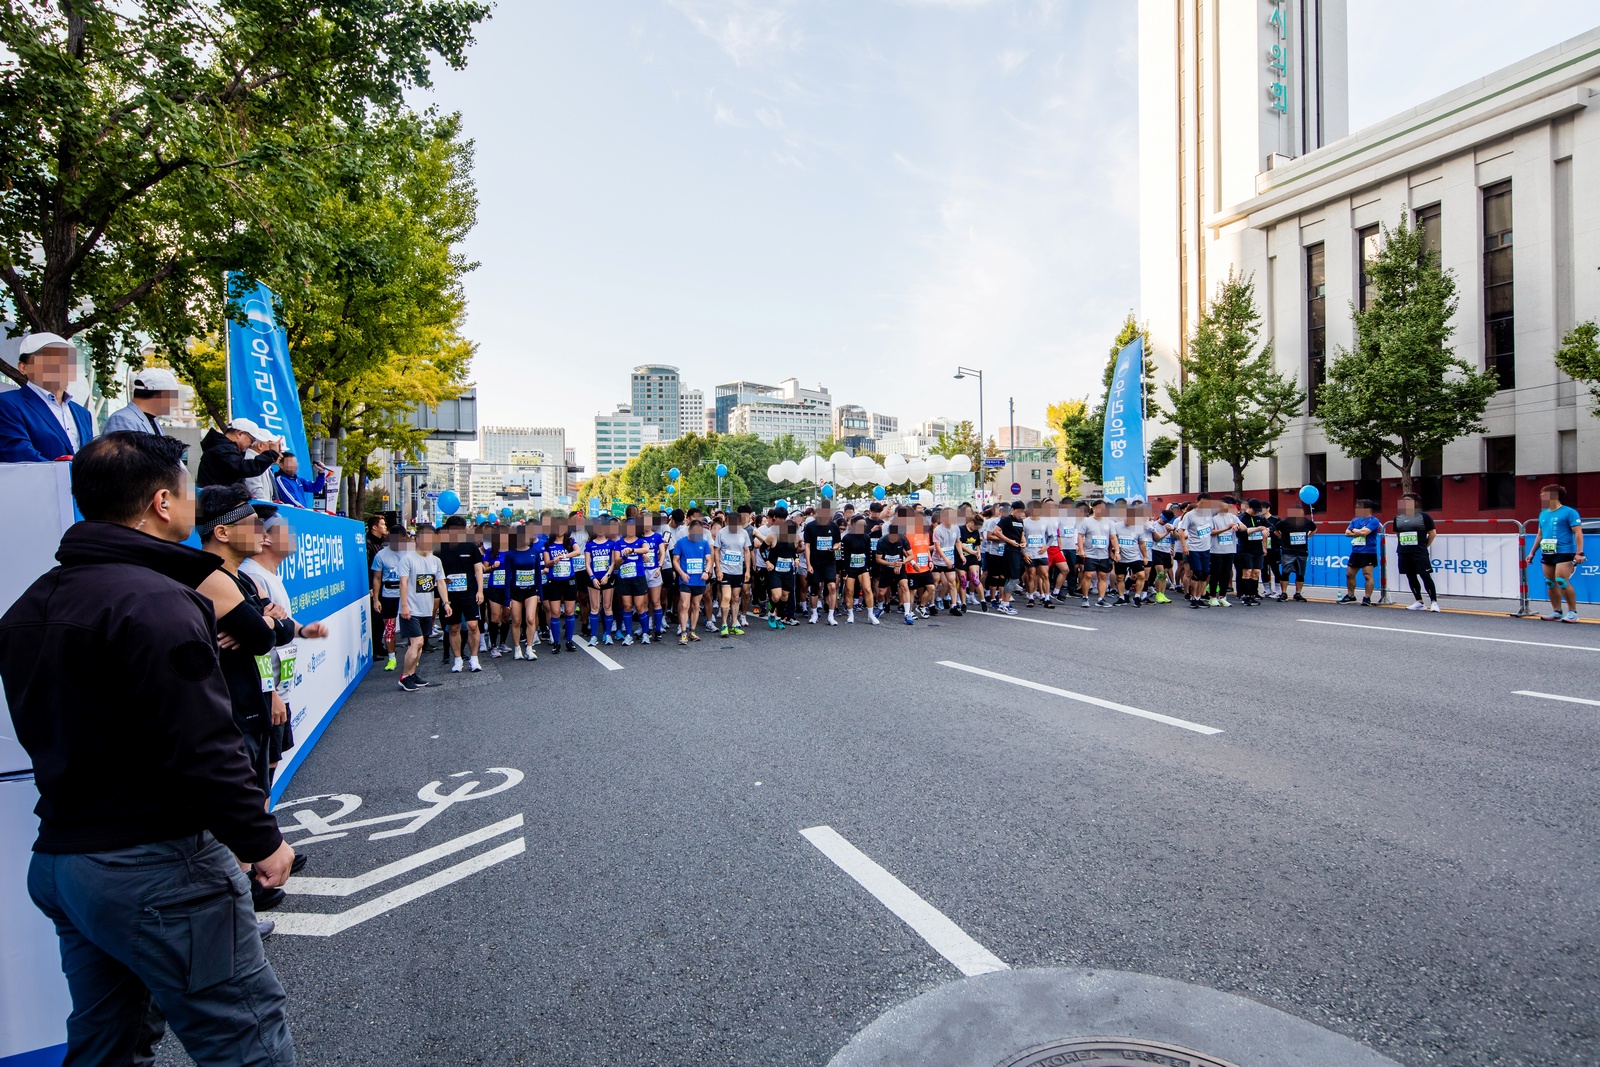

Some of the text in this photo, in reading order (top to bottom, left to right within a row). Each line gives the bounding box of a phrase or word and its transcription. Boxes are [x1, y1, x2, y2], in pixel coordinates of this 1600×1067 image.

[1270, 0, 1287, 114] 시의회
[297, 533, 345, 579] 서울달리기대회
[1431, 558, 1488, 575] 우리은행
[447, 578, 466, 587] 1352
